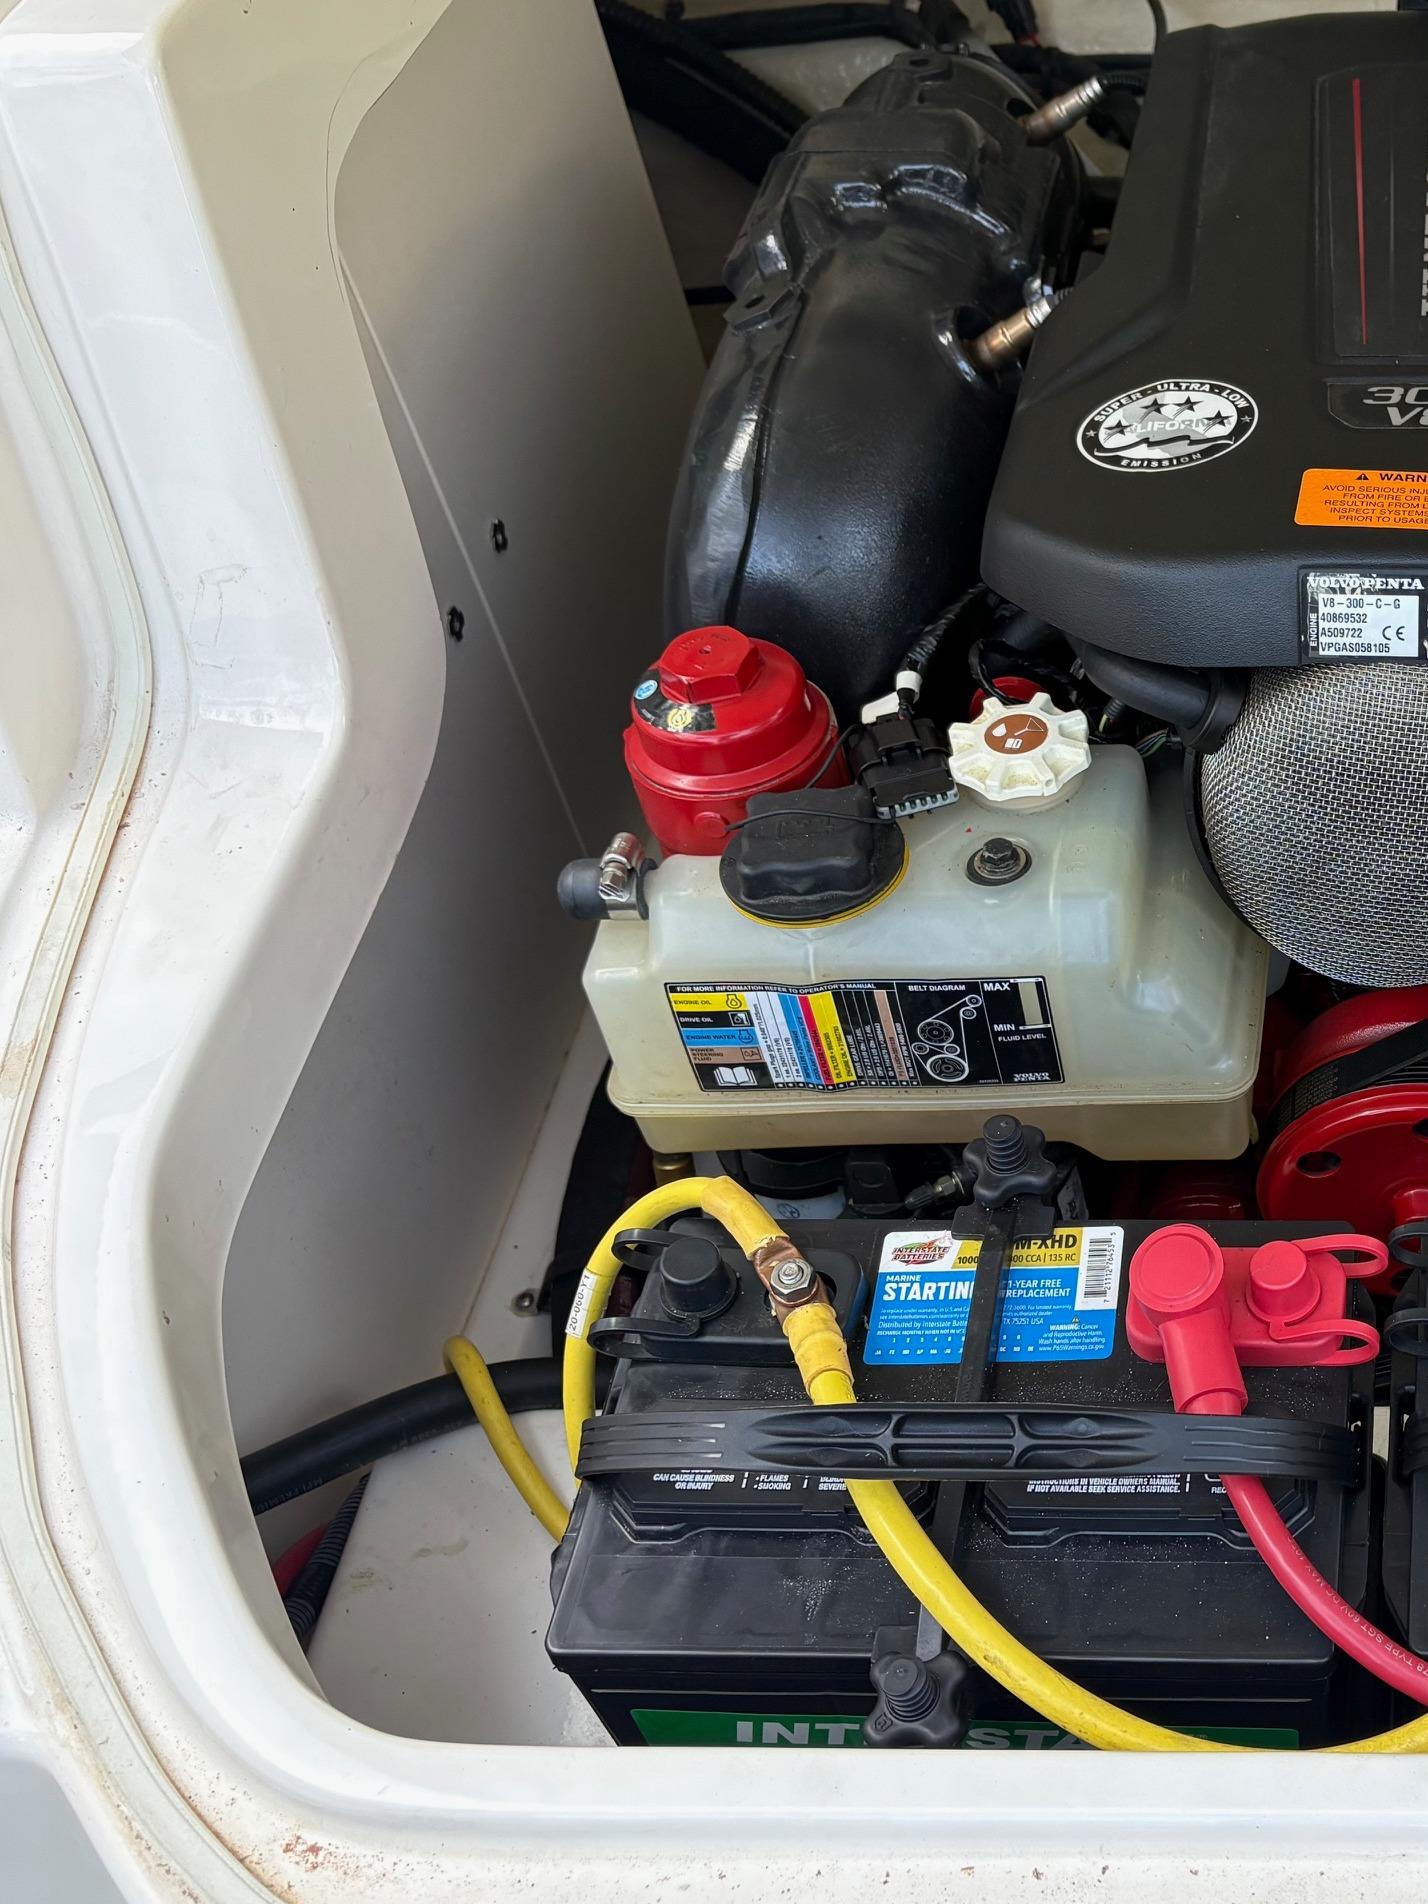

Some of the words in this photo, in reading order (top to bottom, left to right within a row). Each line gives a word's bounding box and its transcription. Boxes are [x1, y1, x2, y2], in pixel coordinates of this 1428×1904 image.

[1094, 392, 1143, 422] SUPER
[1157, 382, 1211, 392] ULTRA
[1221, 389, 1250, 409] LOW
[1120, 453, 1202, 468] EMISSION
[1322, 484, 1355, 493] AVOID
[1358, 485, 1407, 495] SERIOUS
[1343, 492, 1375, 501] FROM
[1377, 493, 1401, 502] FIRE
[1405, 495, 1421, 503] OR
[1324, 499, 1384, 508] RESULTING
[1387, 501, 1419, 510] FROM
[1330, 507, 1376, 516] INSPECT
[1338, 515, 1373, 523] PRIOR
[1375, 516, 1391, 524] TO
[1307, 576, 1361, 588] VOLVO
[1361, 578, 1425, 590] PENTA
[1319, 612, 1368, 624] 40869532
[1309, 612, 1318, 647] ENGINE
[1320, 627, 1363, 638] A509722
[1319, 642, 1391, 653] VPGAS058105
[765, 985, 786, 993] REFER
[799, 983, 846, 995] OPERATOR'S
[908, 984, 928, 992] BELT
[929, 984, 966, 992] DIAGRAM
[983, 982, 1011, 992] MAX
[993, 1024, 1016, 1032] MIN
[1021, 1033, 1047, 1041] LEVEL
[892, 1246, 951, 1254] INTERSTATE
[891, 1253, 945, 1261] BATTERIES
[957, 1256, 979, 1265] 1000
[1025, 1254, 1042, 1262] CCA
[1049, 1253, 1063, 1262] 135
[1065, 1253, 1077, 1261] RC
[886, 1274, 922, 1282] MARINE
[1040, 1279, 1062, 1287] FREE
[1006, 1288, 1071, 1298] REPLACEMENT
[568, 1274, 591, 1332] 20-060-Y1
[878, 1321, 912, 1329] Distributed
[913, 1321, 921, 1329] by
[922, 1320, 951, 1328] Interstate
[1011, 1317, 1029, 1325] 75251
[1031, 1317, 1044, 1325] USA
[653, 1473, 670, 1481] CAN
[669, 1473, 694, 1482] CAUSE
[694, 1474, 735, 1482] BLINDNESS
[1089, 1477, 1117, 1486] VEHICLE
[1118, 1478, 1148, 1486] OWNERS
[675, 1482, 687, 1490] OR
[686, 1482, 714, 1490] INJURY
[818, 1483, 847, 1491] SEVERE
[1027, 1485, 1035, 1493] IF
[1035, 1485, 1050, 1493] NOT
[1050, 1485, 1088, 1493] AVAILABLE
[1088, 1485, 1106, 1493] SEEK
[1106, 1485, 1136, 1493] SERVICE
[1136, 1485, 1181, 1494] ASSISTANCE.
[1360, 1622, 1384, 1643] SGT
[1384, 1642, 1413, 1667] TYPE
